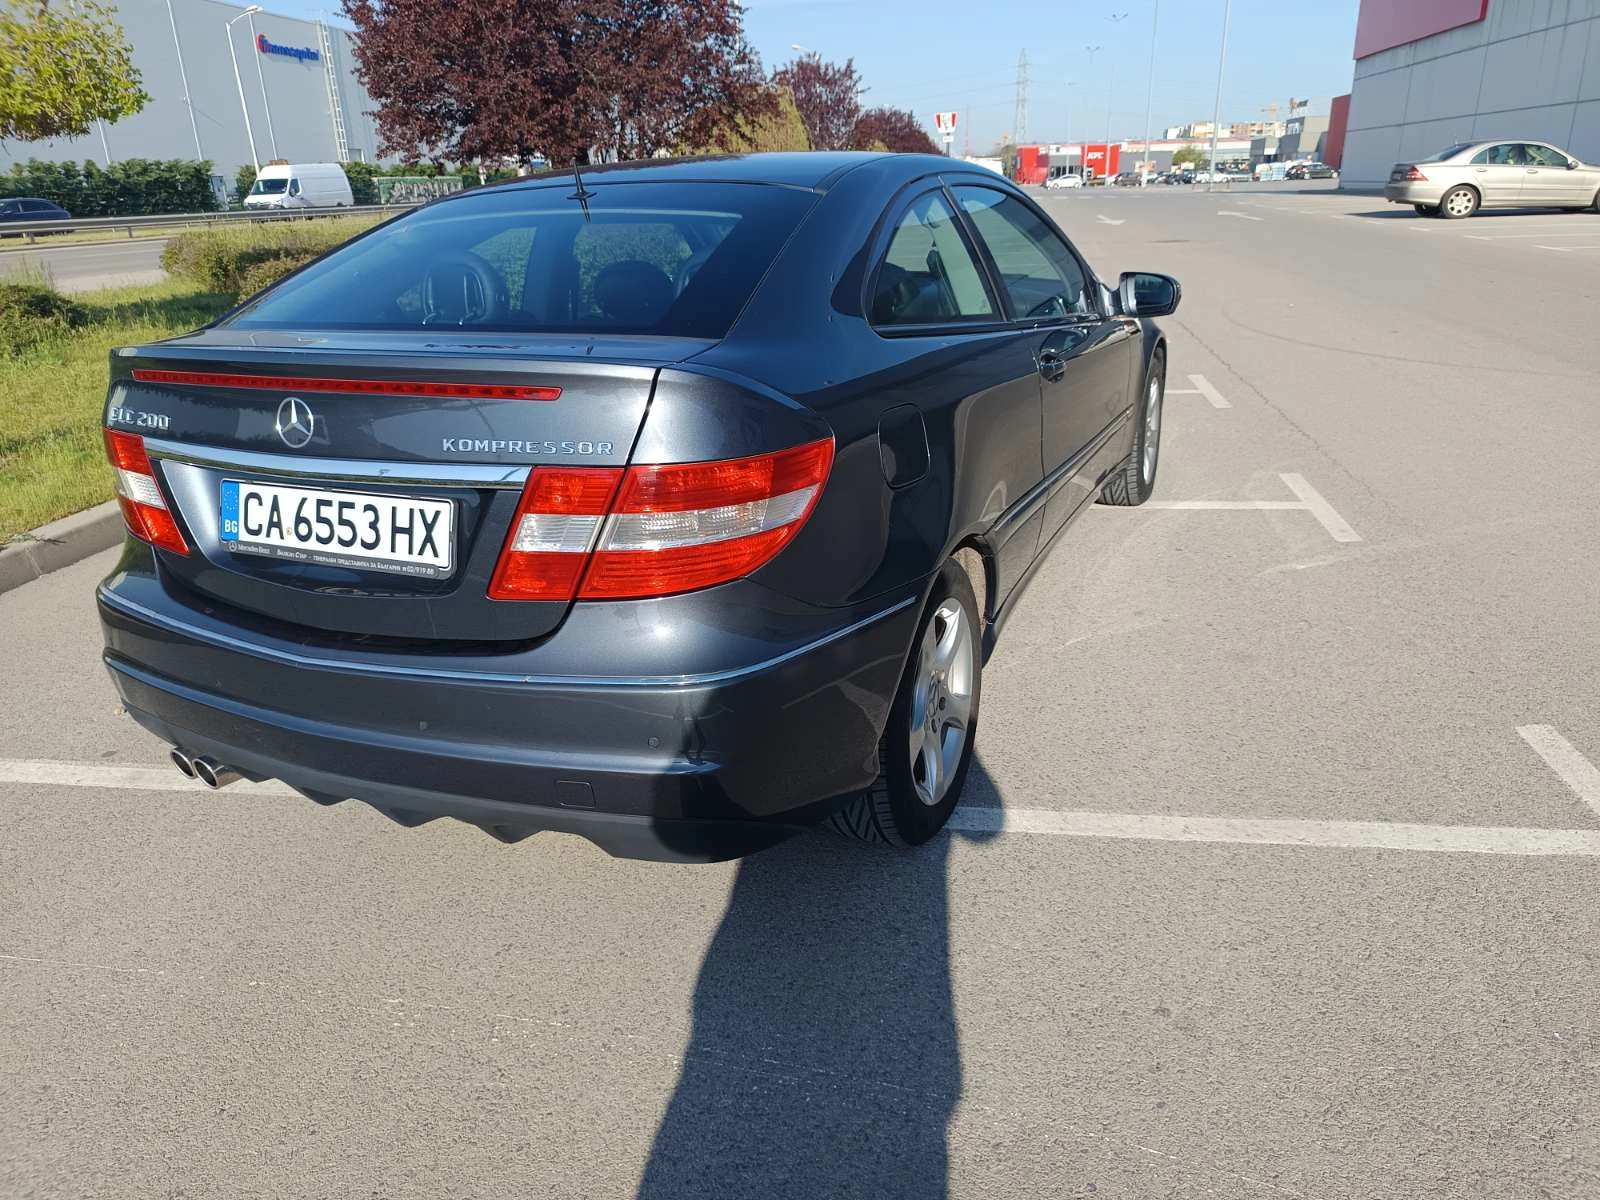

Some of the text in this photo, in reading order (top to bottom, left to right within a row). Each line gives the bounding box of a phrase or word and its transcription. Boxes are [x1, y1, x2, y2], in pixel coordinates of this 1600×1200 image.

[1087, 151, 1105, 160] KFC
[137, 411, 169, 430] 200
[442, 438, 614, 455] KOMPRESSOR
[224, 520, 238, 533] BG
[244, 492, 442, 558] CA 6553 HX
